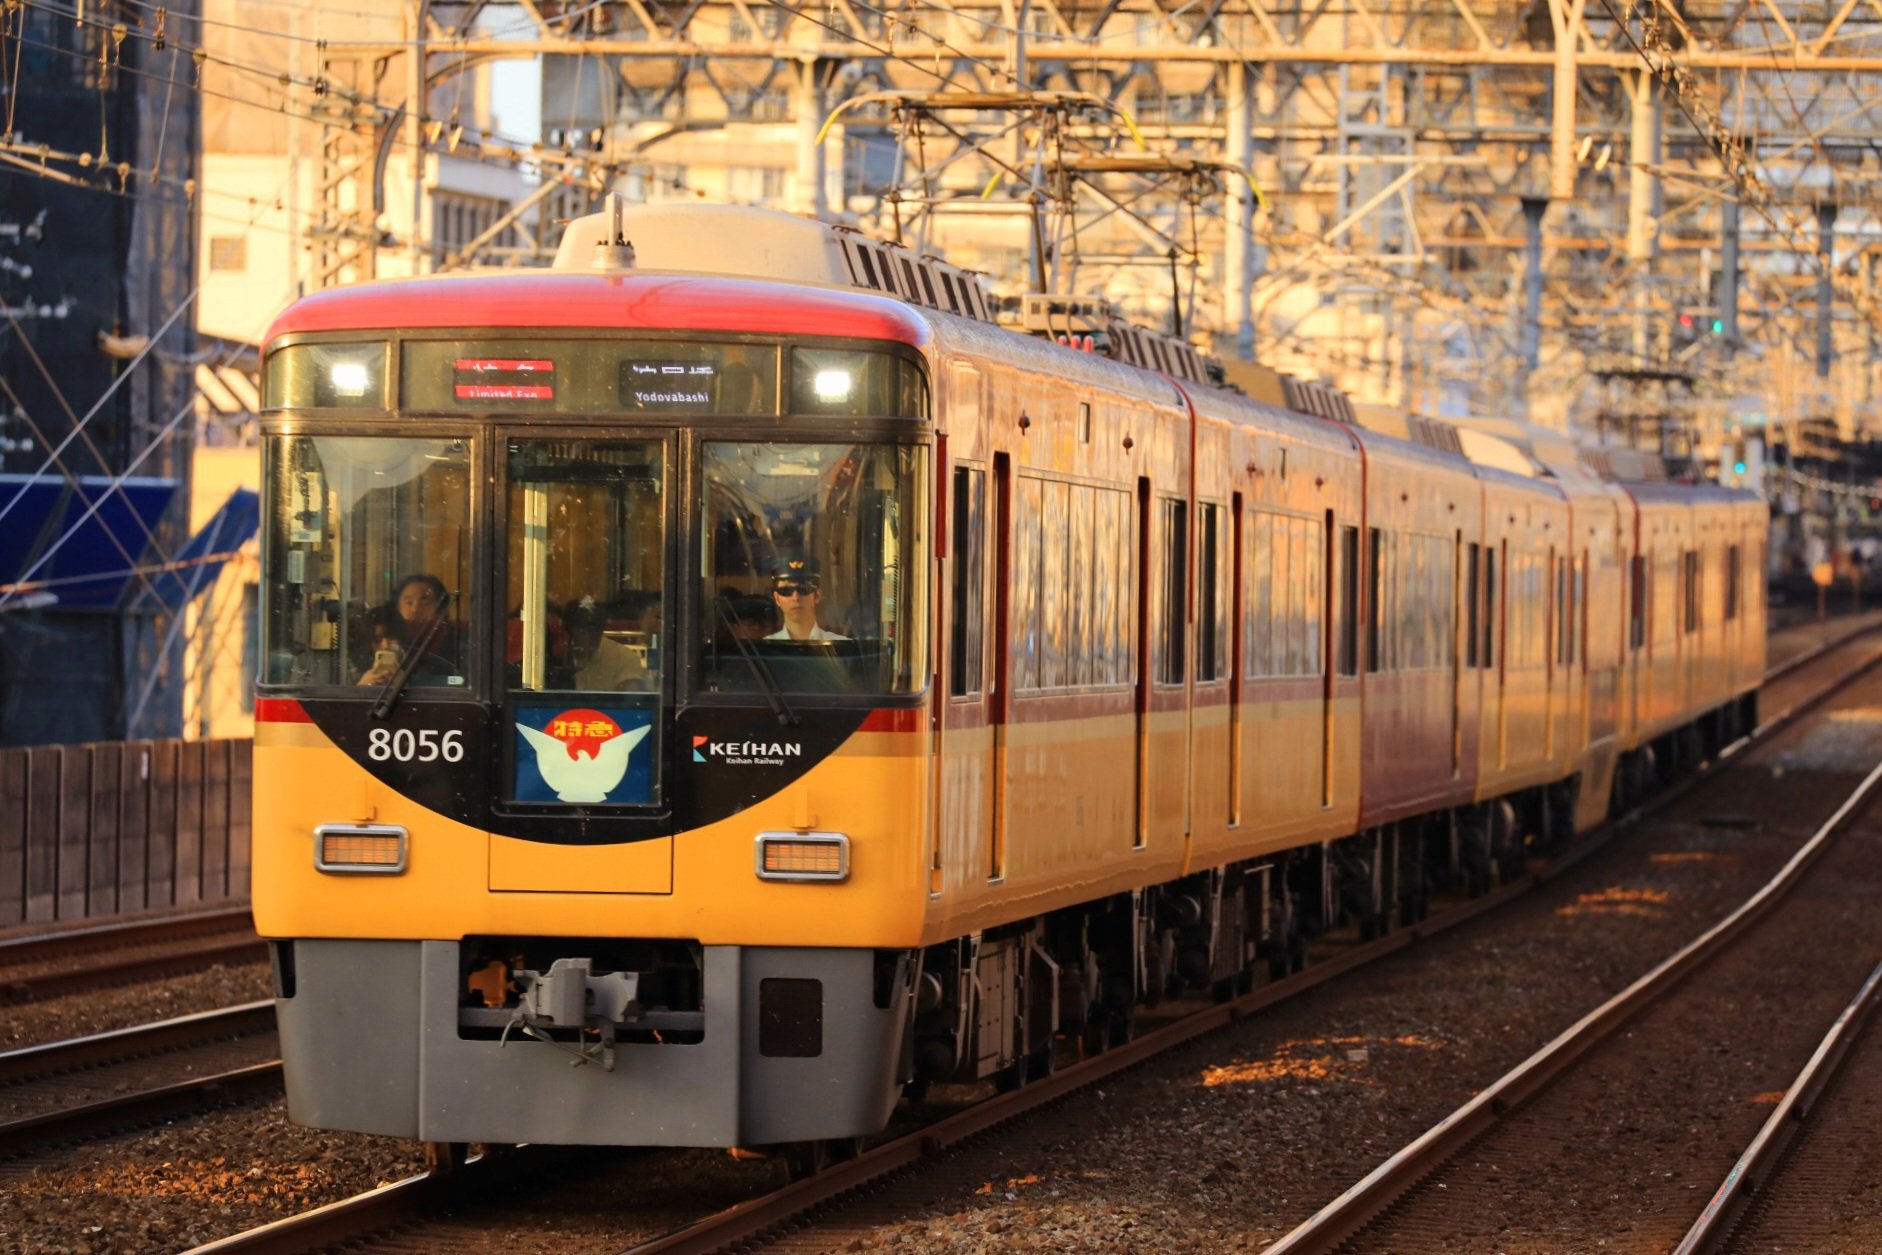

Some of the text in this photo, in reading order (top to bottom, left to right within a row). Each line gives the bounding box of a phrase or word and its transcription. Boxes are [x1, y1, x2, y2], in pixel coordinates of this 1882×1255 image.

[553, 720, 613, 737] 特急
[368, 728, 464, 763] 8056
[709, 741, 801, 756] KEIHAN
[726, 757, 784, 766] Keihan Railway
